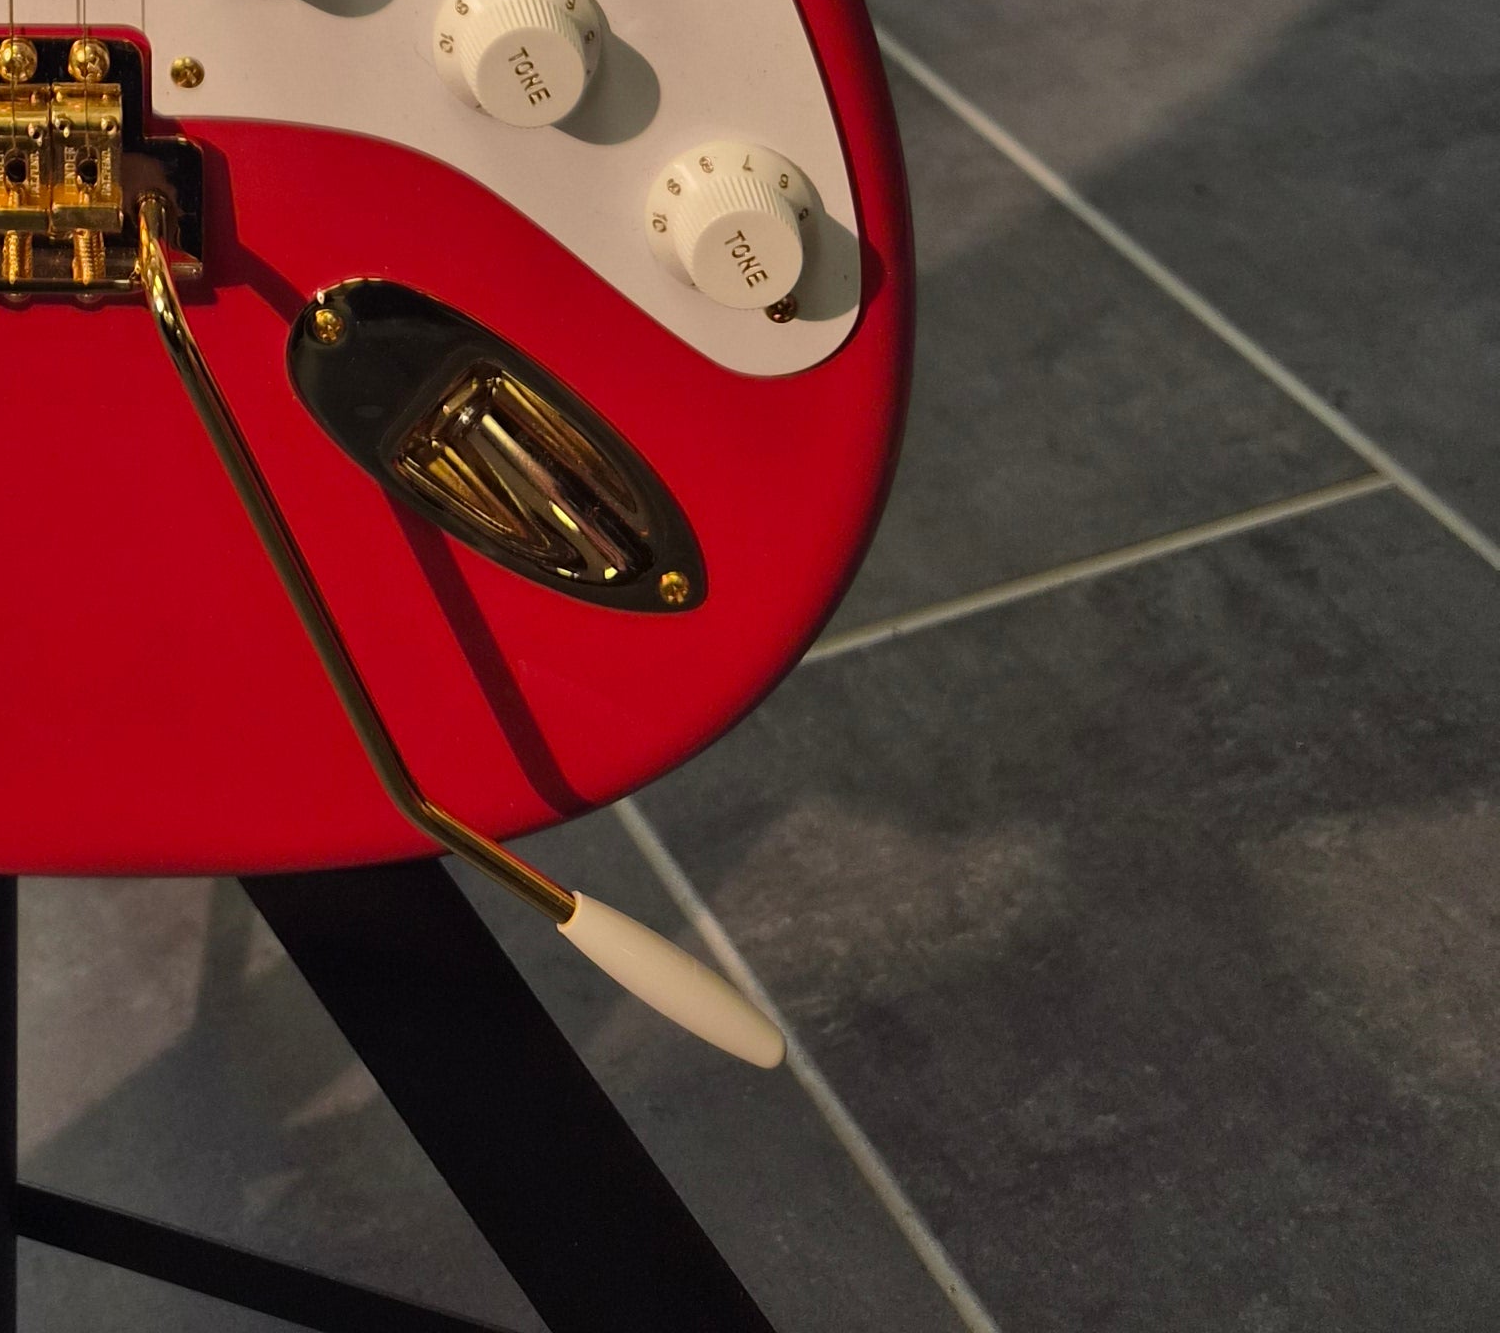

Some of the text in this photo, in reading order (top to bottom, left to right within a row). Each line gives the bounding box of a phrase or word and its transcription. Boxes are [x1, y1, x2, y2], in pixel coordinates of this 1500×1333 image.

[439, 33, 455, 54] 10
[508, 46, 551, 106] TONE
[742, 154, 753, 172] 7
[652, 212, 668, 233] 10
[724, 230, 769, 288] TONE
